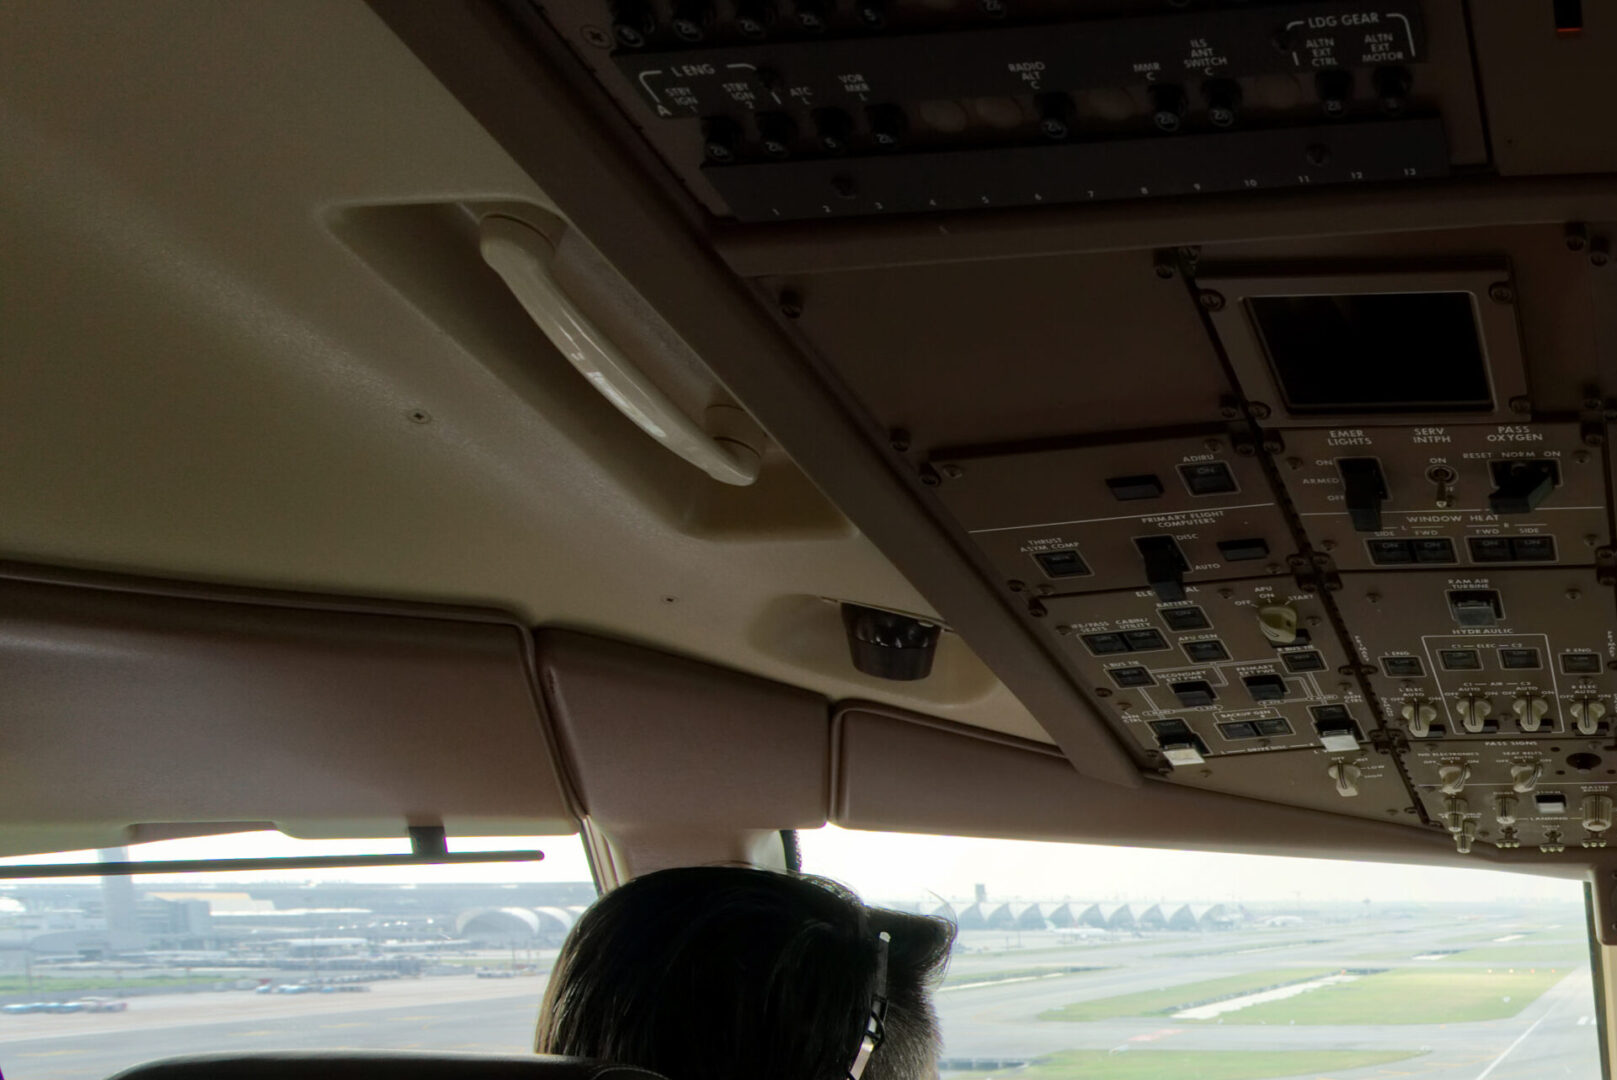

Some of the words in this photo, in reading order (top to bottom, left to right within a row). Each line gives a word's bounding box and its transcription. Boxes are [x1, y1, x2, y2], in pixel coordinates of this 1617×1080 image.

[1308, 17, 1337, 28] LDG
[1342, 13, 1379, 26] GEAR
[1365, 33, 1393, 43] ALTN
[1306, 38, 1335, 48] ALTN
[1371, 43, 1390, 53] EXT
[1313, 48, 1332, 58] EXT
[1362, 52, 1404, 62] MOTOR
[1184, 57, 1228, 68] SWITCH
[1311, 57, 1338, 67] CTRL
[682, 65, 715, 76] ENG
[1008, 62, 1046, 73] RADIO
[657, 104, 672, 117] A
[1329, 429, 1365, 438] EMER
[1414, 428, 1445, 436] SERV
[1498, 426, 1530, 434] PASS
[1327, 437, 1373, 446] LIGHTS
[1413, 435, 1451, 444] INTPH
[1487, 433, 1543, 442] OXYGEN
[1182, 454, 1215, 463] ADIRU
[1463, 452, 1493, 460] RESET
[1502, 451, 1536, 459] NORM
[1544, 450, 1561, 459] ON
[1316, 459, 1333, 467] ON
[1430, 457, 1447, 465] ON
[1302, 476, 1340, 485] ARMED
[1142, 514, 1193, 524] PRIMARY
[1195, 510, 1224, 519] FLIGHT
[1407, 515, 1463, 523] WINDOW
[1470, 514, 1499, 523] HEAT
[1158, 518, 1216, 529] COMPUTERS
[1028, 537, 1063, 546] THRUST
[1177, 533, 1198, 541] DISC
[1195, 563, 1221, 571] AUTO
[1452, 628, 1514, 636] HYDRAULIC
